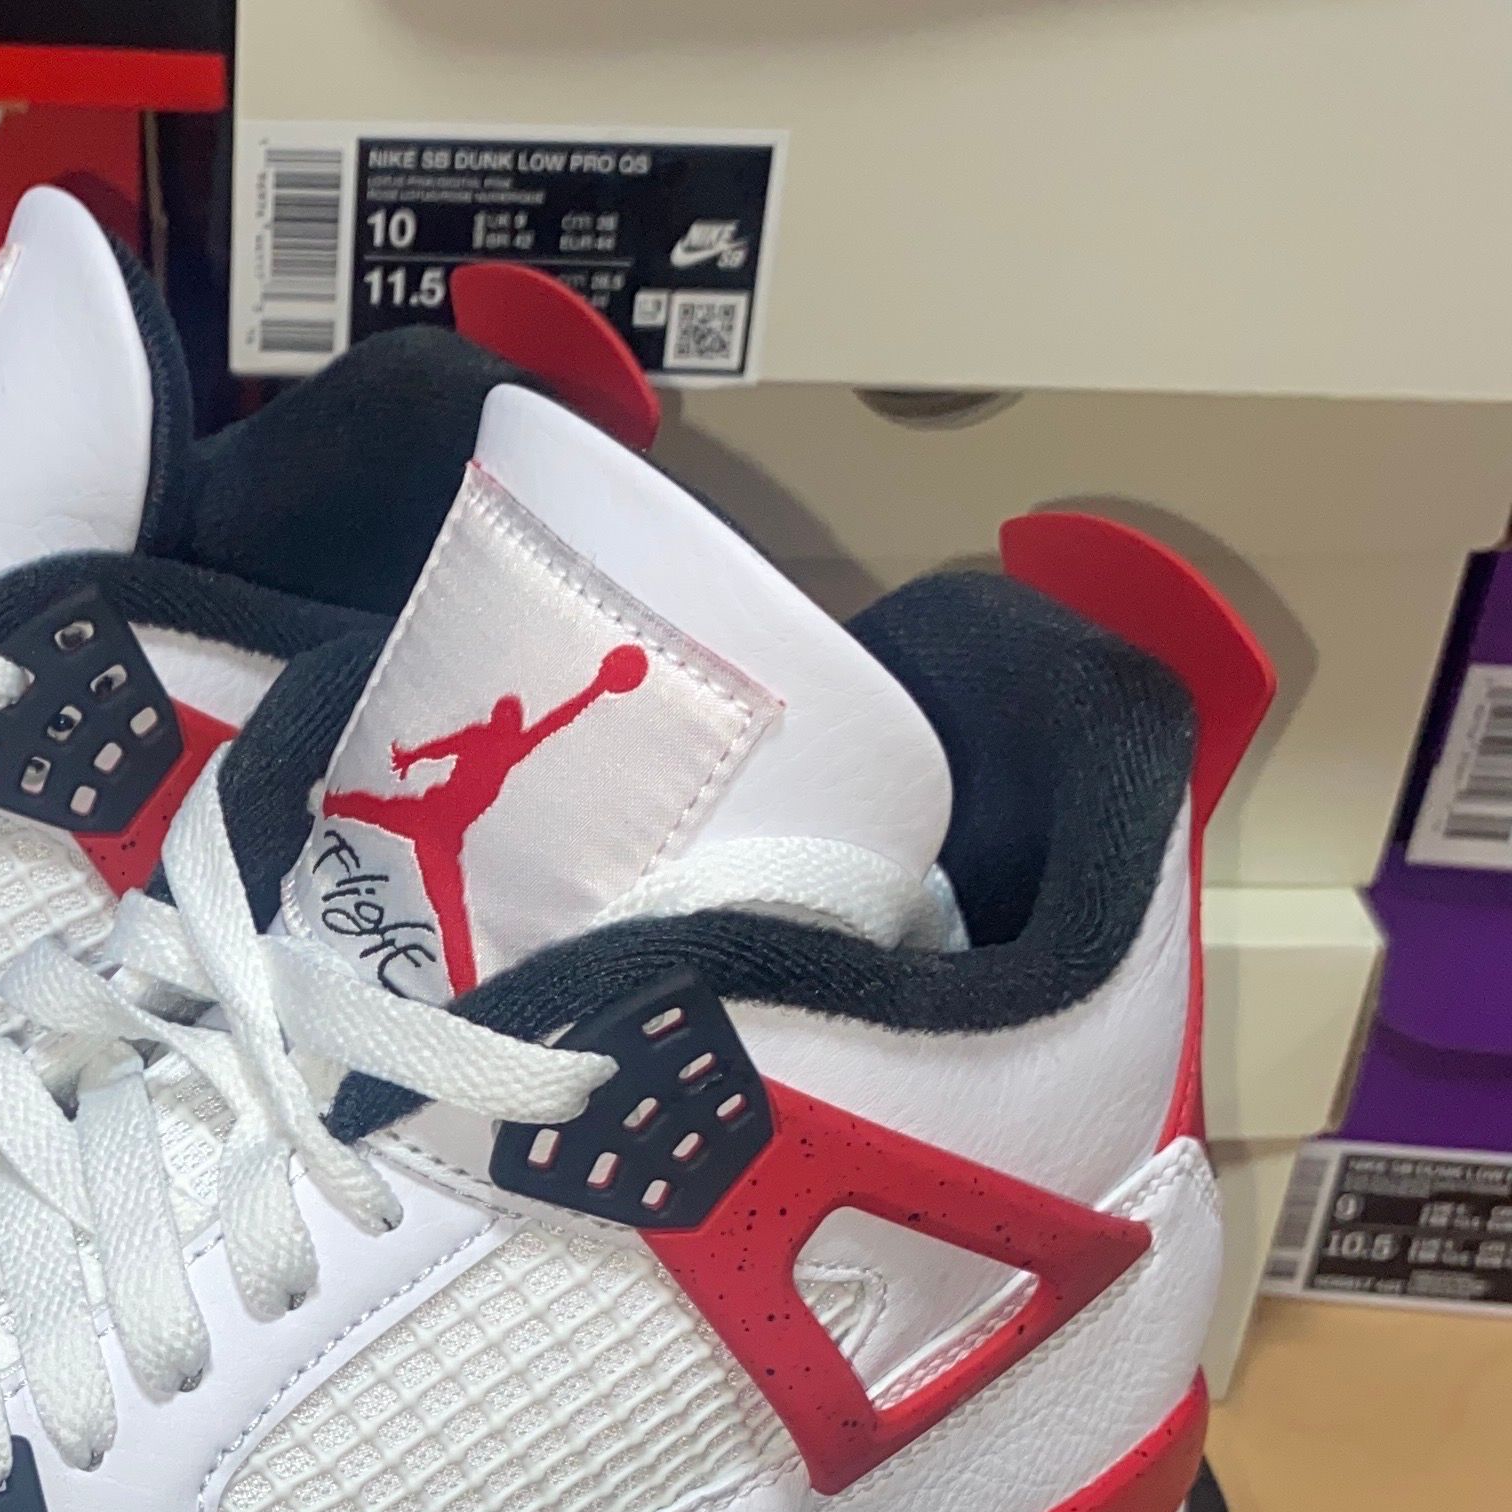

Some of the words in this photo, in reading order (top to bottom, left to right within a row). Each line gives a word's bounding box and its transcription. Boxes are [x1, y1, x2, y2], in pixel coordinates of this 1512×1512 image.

[368, 148, 418, 169] NIKE
[421, 149, 452, 170] SB
[454, 150, 514, 171] DUNK
[518, 151, 568, 173] LOW
[569, 152, 616, 173] PRO
[366, 207, 418, 249] 10
[363, 266, 448, 309] 11.5
[312, 829, 437, 1002] Flight
